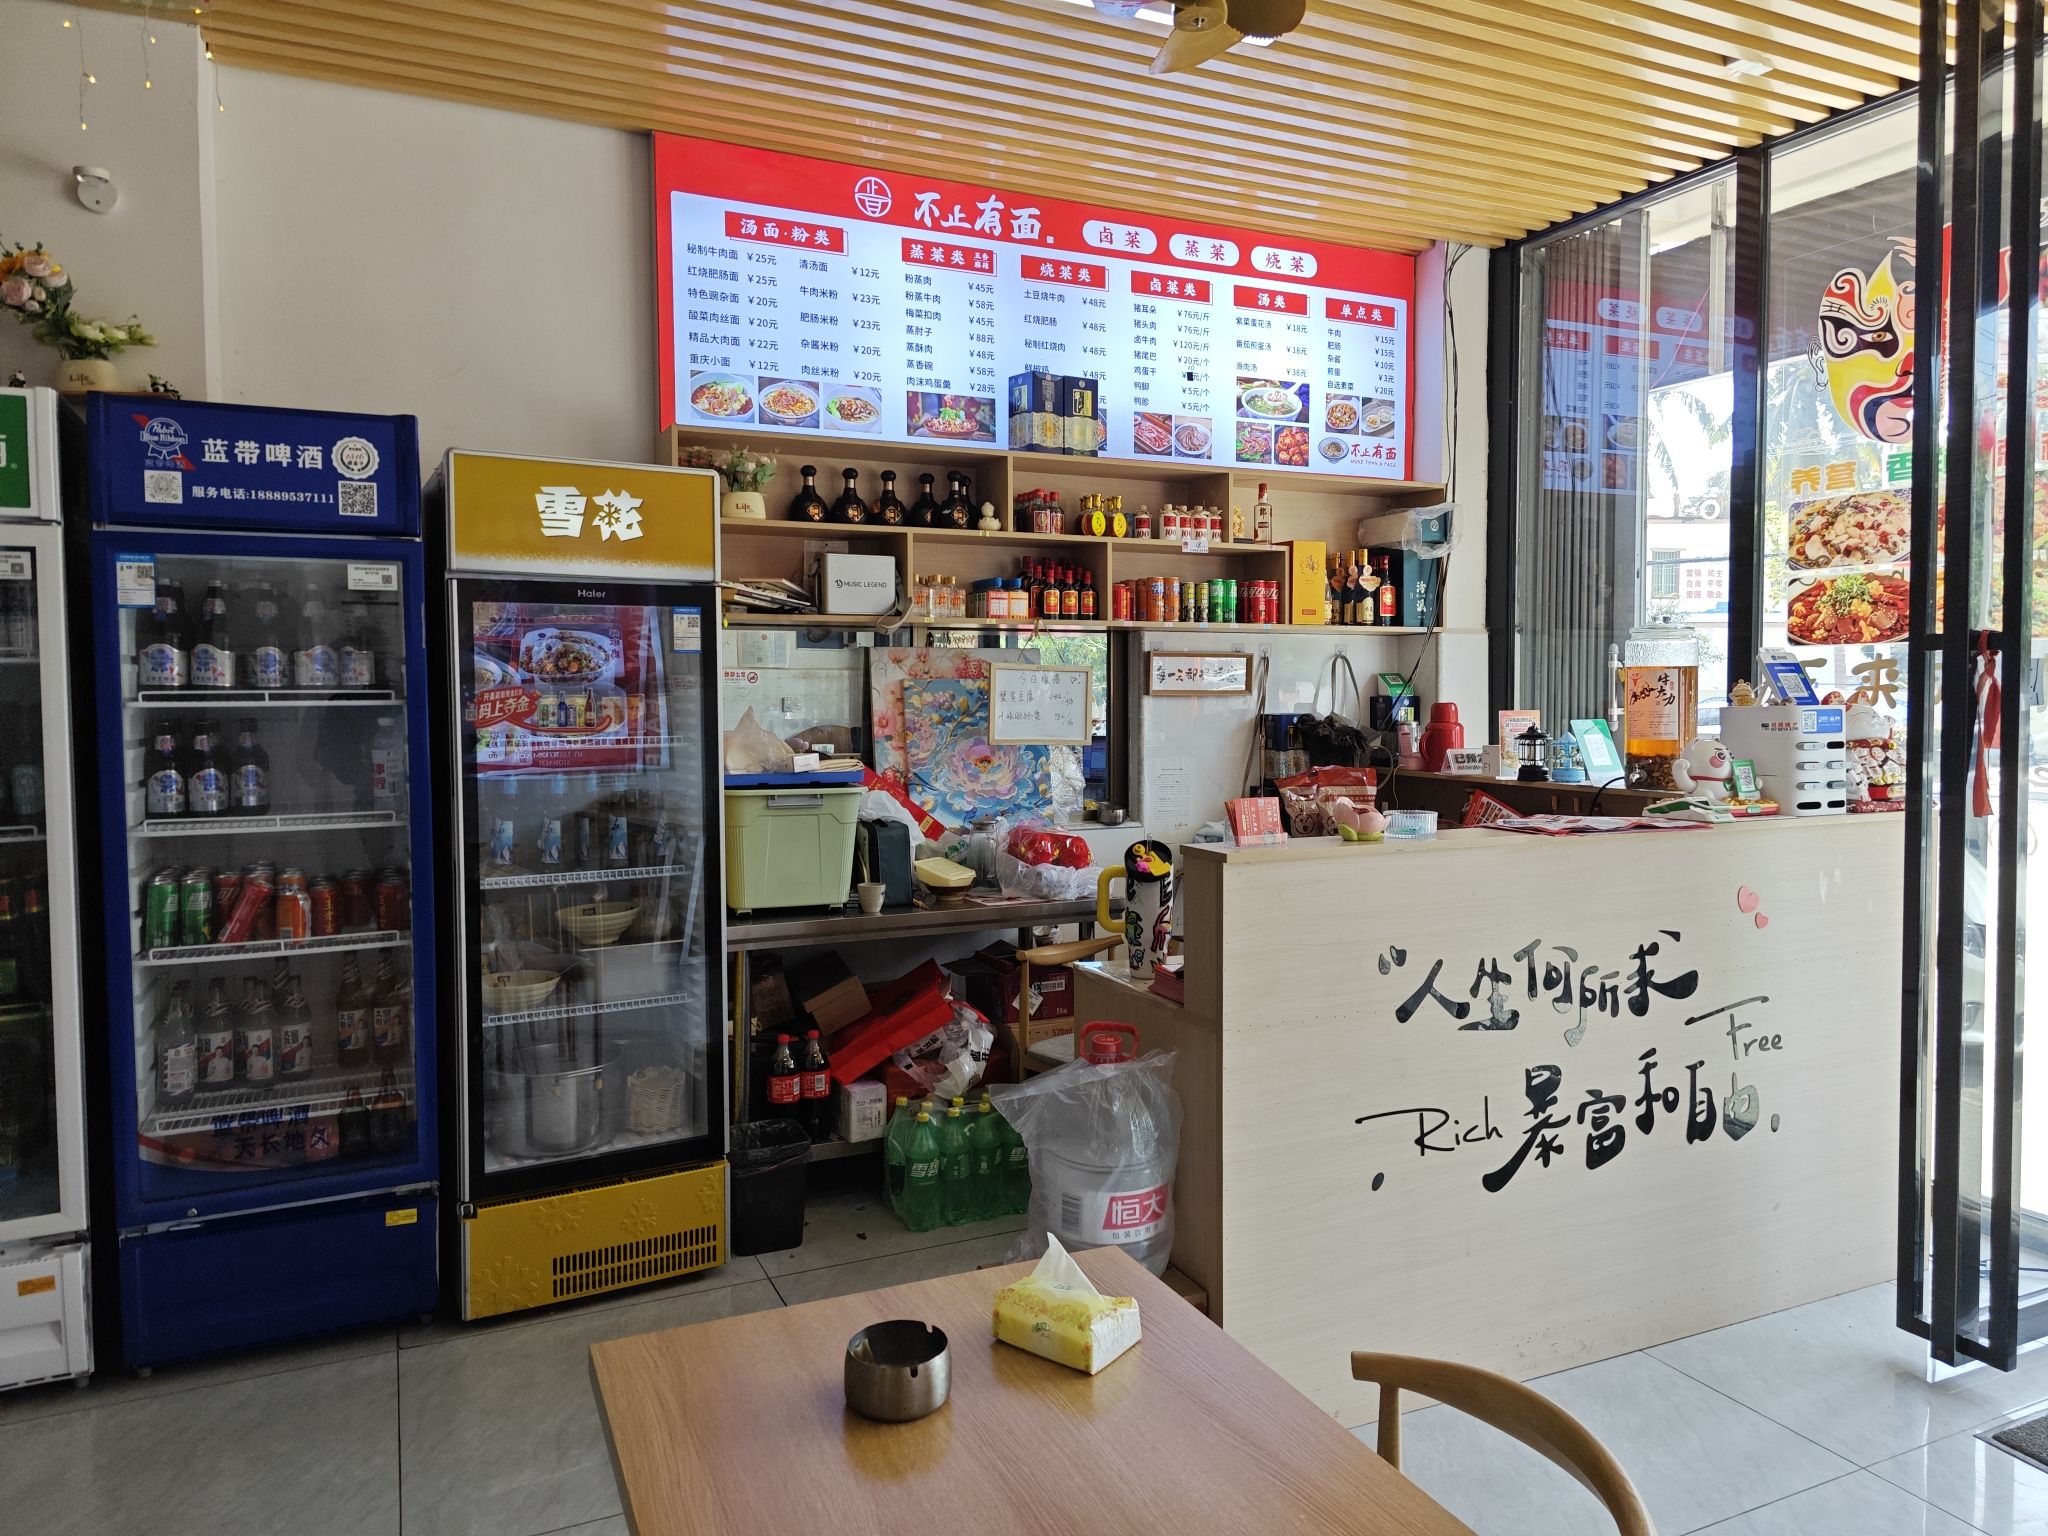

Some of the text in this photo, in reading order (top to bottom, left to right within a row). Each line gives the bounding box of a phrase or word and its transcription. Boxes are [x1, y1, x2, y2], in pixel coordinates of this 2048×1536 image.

[1099, 226, 1141, 249] 卤菜
[686, 242, 777, 266] 秘制牛肉面 ¥25元
[909, 244, 966, 266] 蒸菜类
[1185, 240, 1225, 262] 蒸菜
[799, 258, 880, 280] 清汤面 ¥12元
[1265, 252, 1305, 273] 烧菜
[687, 265, 778, 287] 红烧肥肠面 ¥25元
[1040, 262, 1091, 283] 烧菜类
[905, 273, 994, 294] 粉蒸肉 ¥45元
[1150, 277, 1198, 297] 卤菜类
[748, 296, 778, 308] ¥20元
[799, 285, 880, 306] 牛肉米粉 ¥23元
[905, 290, 995, 311] 粉蒸牛肉 ¥58元
[1024, 290, 1106, 308] 土豆烧牛肉 ¥48元
[1257, 292, 1287, 309] 汤类
[688, 310, 778, 330] 酸菜肉丝面 ¥20元
[905, 308, 995, 328] 梅菜扣肉 ¥45元
[1133, 304, 1210, 320] 猪耳朵 ¥76元/斤
[1340, 304, 1383, 322] 单点类
[800, 311, 881, 332] 肥肠米粉 ¥23元
[1024, 314, 1107, 332] 红烧肥肠 ¥48元
[1133, 319, 1210, 336] 猪头肉 ¥76元/斤
[1287, 324, 1307, 333] ¥18元
[688, 332, 779, 351] 精品大肉面 ¥22元
[906, 325, 995, 344] 蒸肘子 ¥88元
[1134, 335, 1210, 351] 卤牛肉 ¥120元/斤
[1328, 329, 1395, 345] 牛肉 ¥15元
[852, 345, 881, 357] ¥20元
[906, 342, 995, 361] 蒸酥肉 ¥48元
[1024, 339, 1107, 356] 秘制红烧肉 ¥48元
[1328, 342, 1395, 358] 肥肠 ¥15元
[689, 354, 779, 372] 重庆小面 ¥12元
[1134, 351, 1210, 366] 猪尾巴 ¥20元/个
[1375, 361, 1395, 371] ¥10元
[801, 364, 882, 383] 肉丝米粉 ¥20元
[969, 366, 995, 378] ¥58元
[1182, 372, 1210, 381] ¥元/个
[1379, 374, 1394, 384] ¥3元
[969, 382, 996, 394] ¥28元
[1134, 382, 1210, 397] 鸭脚 ¥5元/个
[1327, 381, 1394, 396] 自选素菜 ¥20元
[1182, 402, 1210, 412] ¥5元/个
[160, 434, 185, 444] Ribbon
[201, 437, 323, 470] 蓝带啤酒
[1351, 443, 1397, 460] 不止有面
[535, 486, 645, 542] 雪花
[843, 580, 887, 589] MUSIC LEGEND
[577, 589, 606, 599] Haier
[1685, 996, 1783, 1060] Free
[1355, 1096, 1503, 1156] Rich
[1112, 1192, 1162, 1226] 恒大
